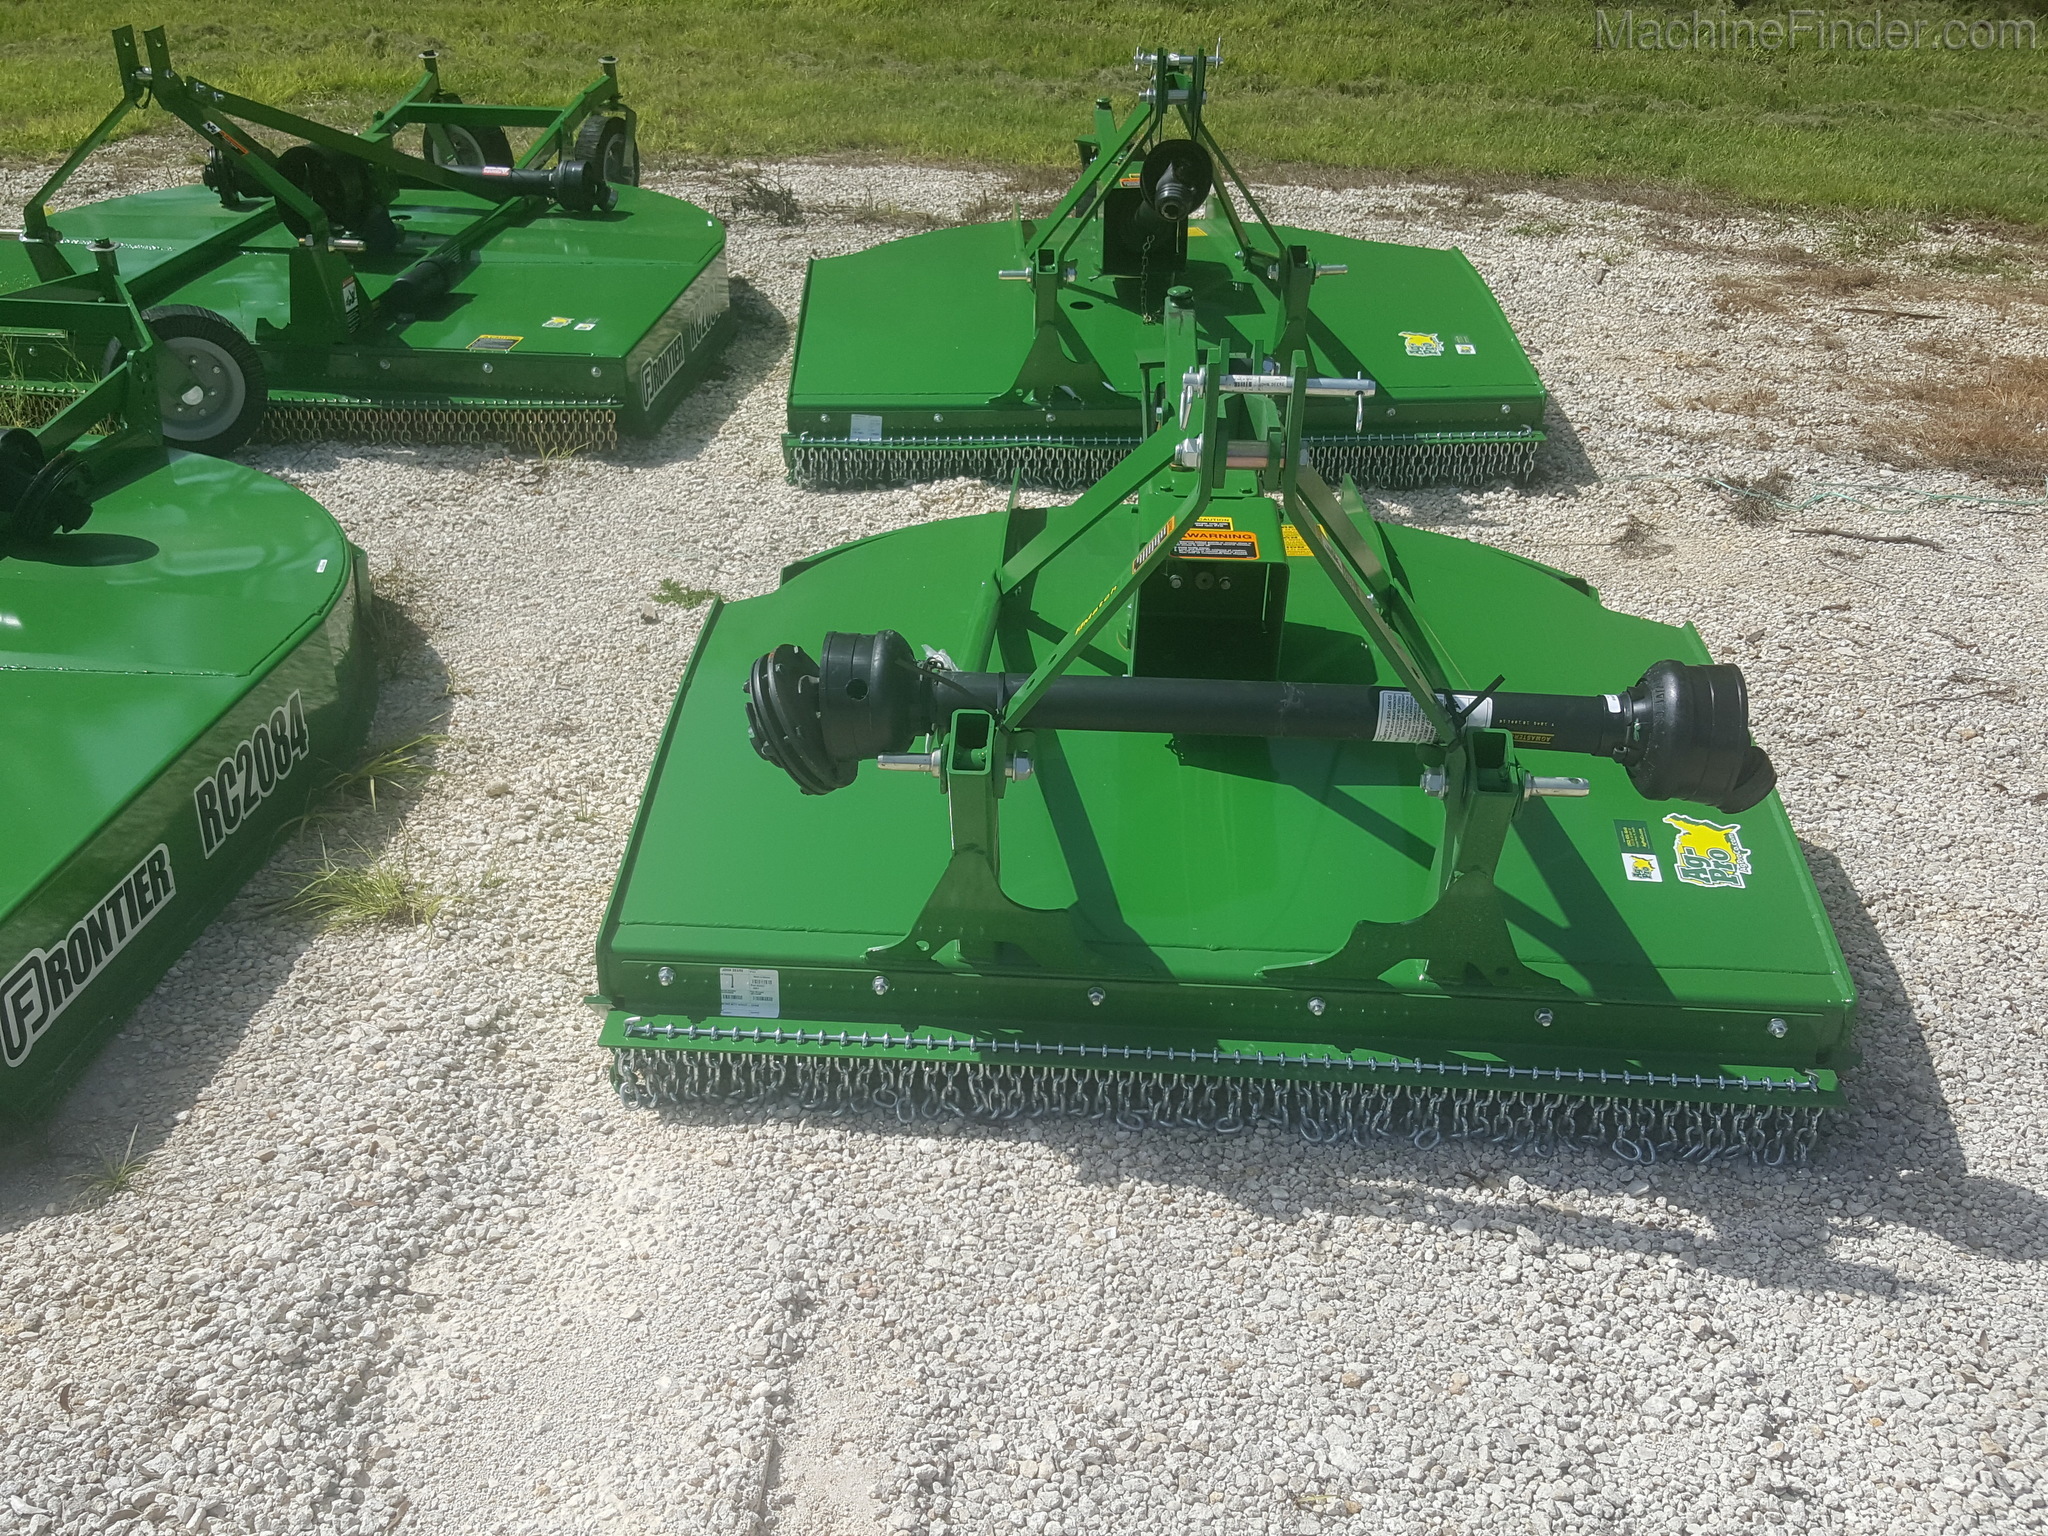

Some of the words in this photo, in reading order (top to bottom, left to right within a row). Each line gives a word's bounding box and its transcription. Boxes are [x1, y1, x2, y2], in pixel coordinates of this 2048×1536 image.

[641, 333, 685, 411] FRONTIER
[1186, 532, 1253, 540] WARNING
[194, 689, 309, 859] RC2084
[1680, 847, 1711, 884] Ag-
[1707, 848, 1741, 886] Pro
[0, 845, 176, 1065] FRONTIER
